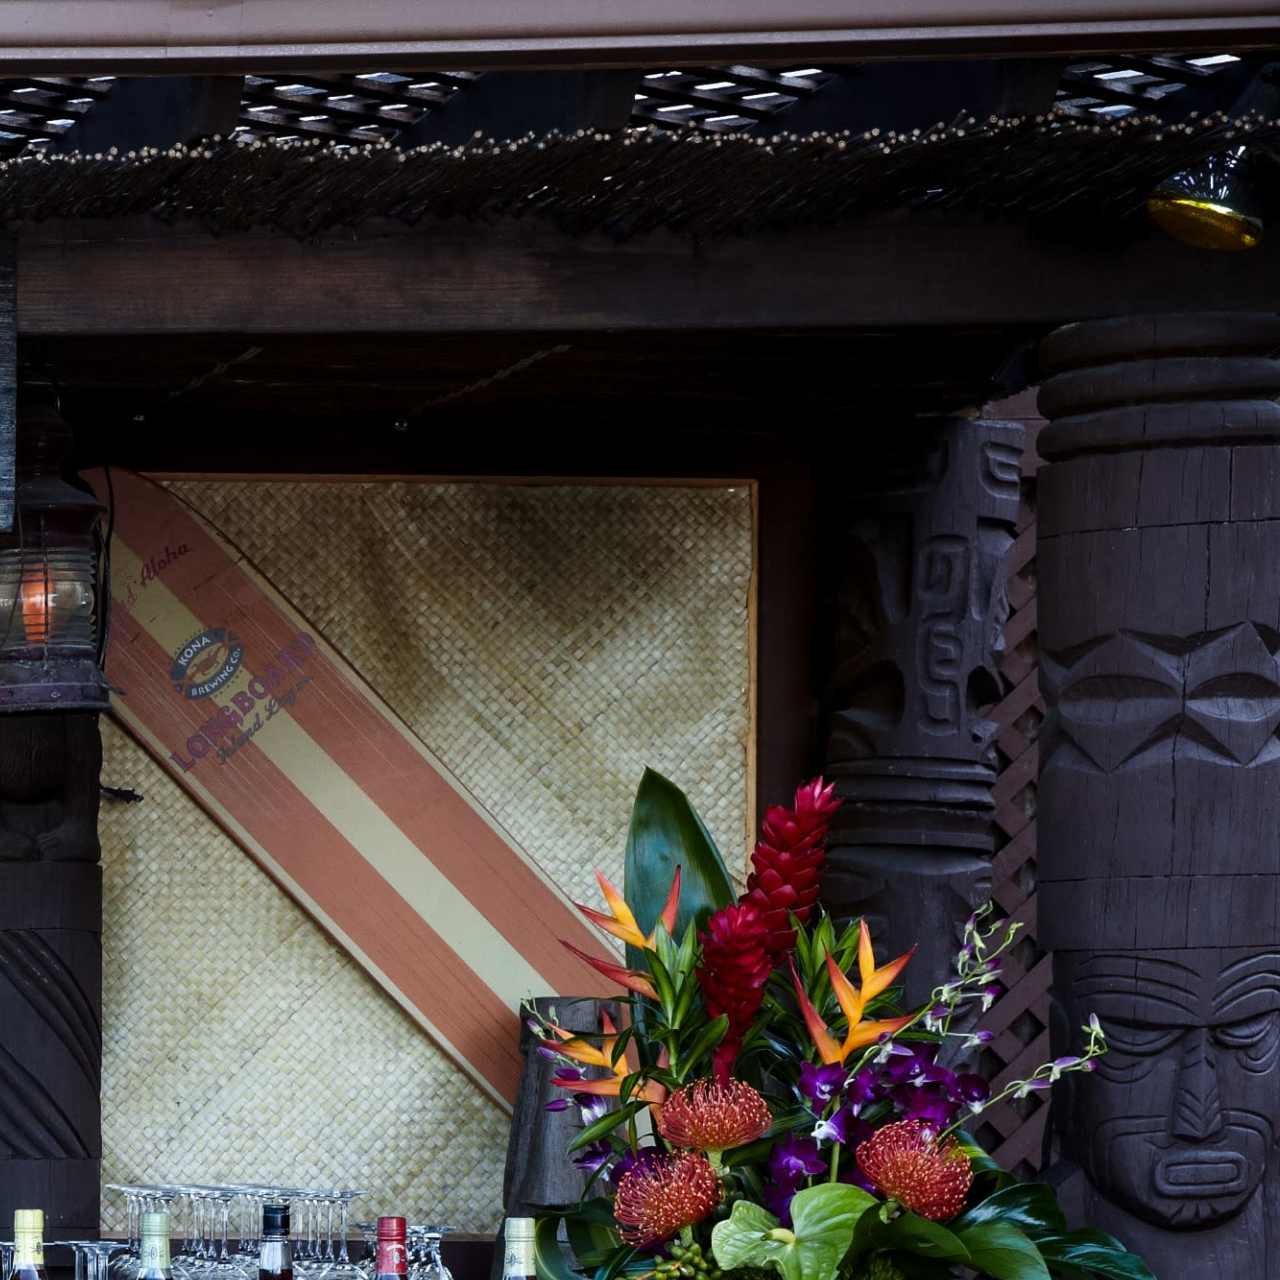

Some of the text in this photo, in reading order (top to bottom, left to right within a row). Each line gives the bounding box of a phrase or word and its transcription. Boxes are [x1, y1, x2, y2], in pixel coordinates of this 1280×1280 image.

[178, 636, 211, 667] KONA
[191, 665, 234, 697] BREWING
[169, 631, 316, 773] LONGBOARD
